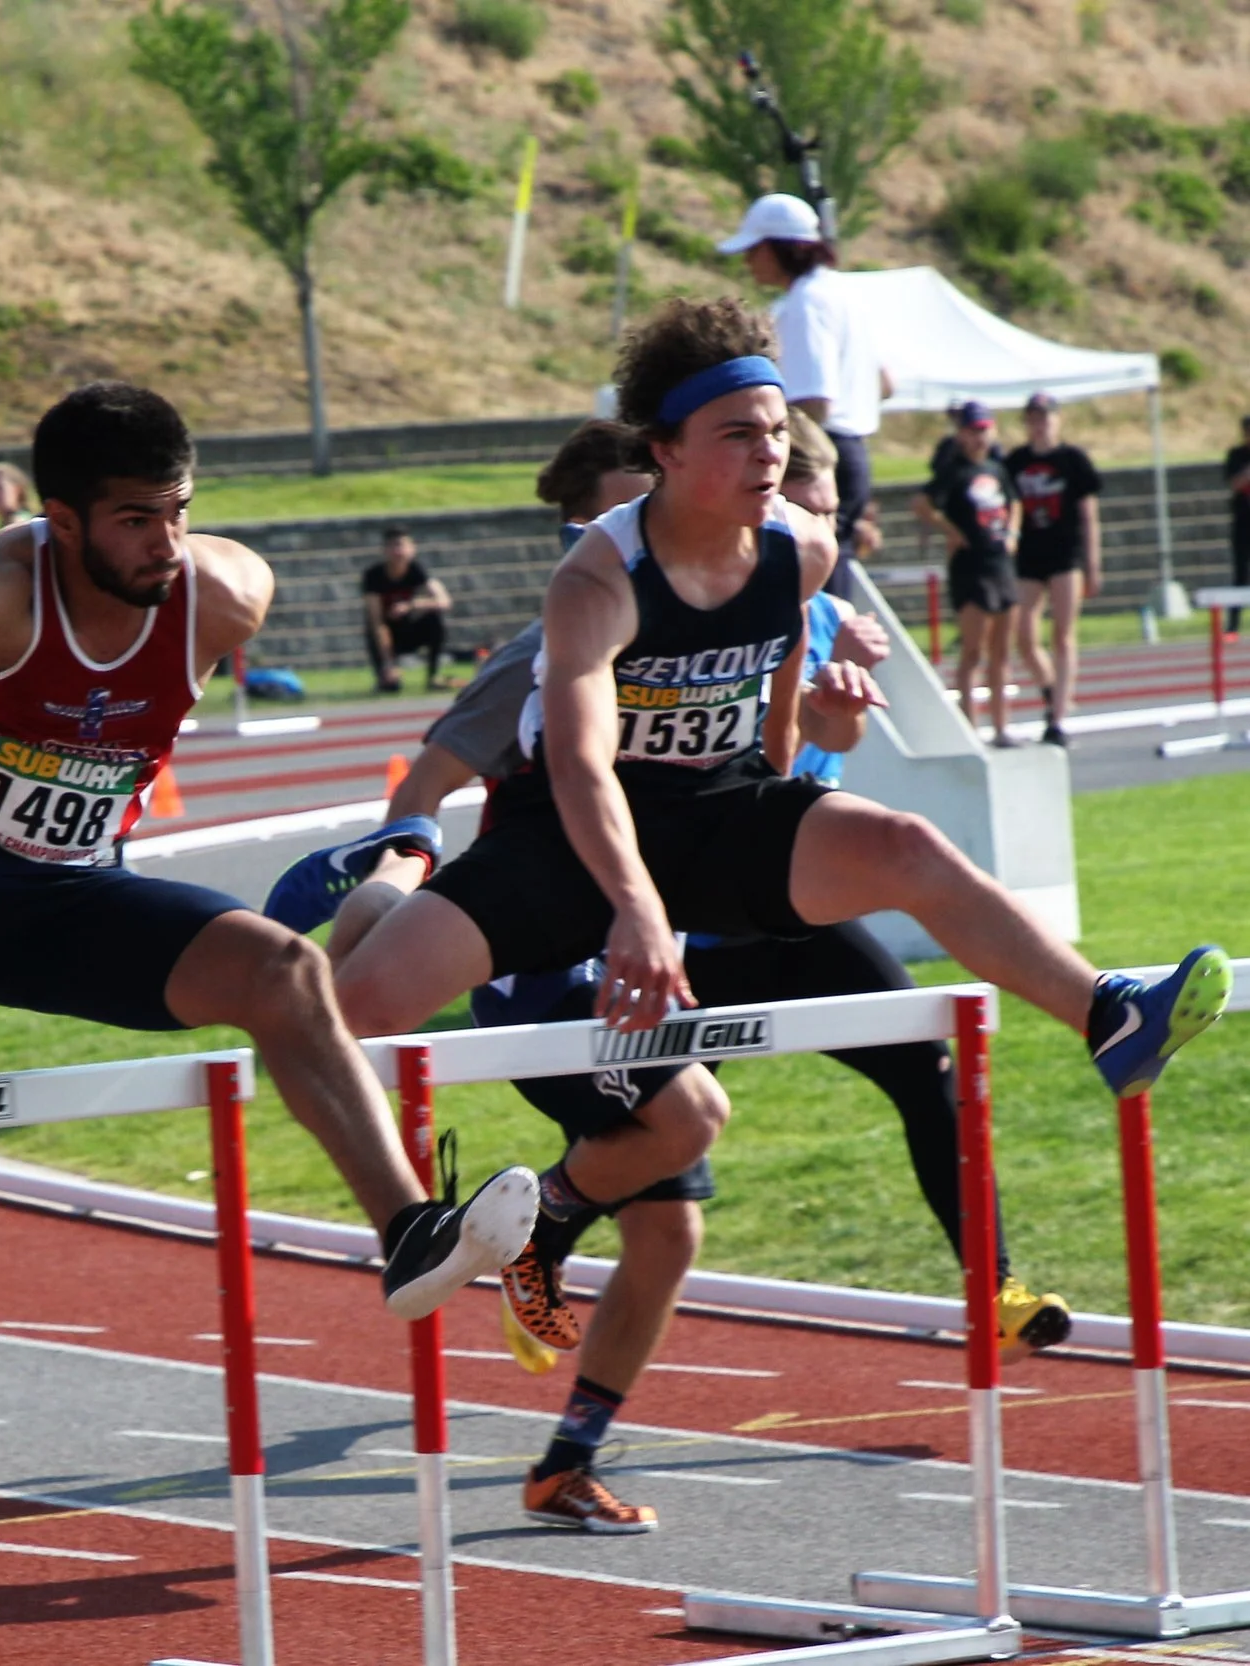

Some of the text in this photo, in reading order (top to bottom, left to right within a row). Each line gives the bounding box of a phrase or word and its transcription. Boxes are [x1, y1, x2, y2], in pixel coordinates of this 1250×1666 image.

[616, 634, 789, 684] SEYCOVE
[617, 682, 745, 706] SUBWAY
[617, 704, 741, 757] 1532
[701, 1019, 766, 1049] GILL
